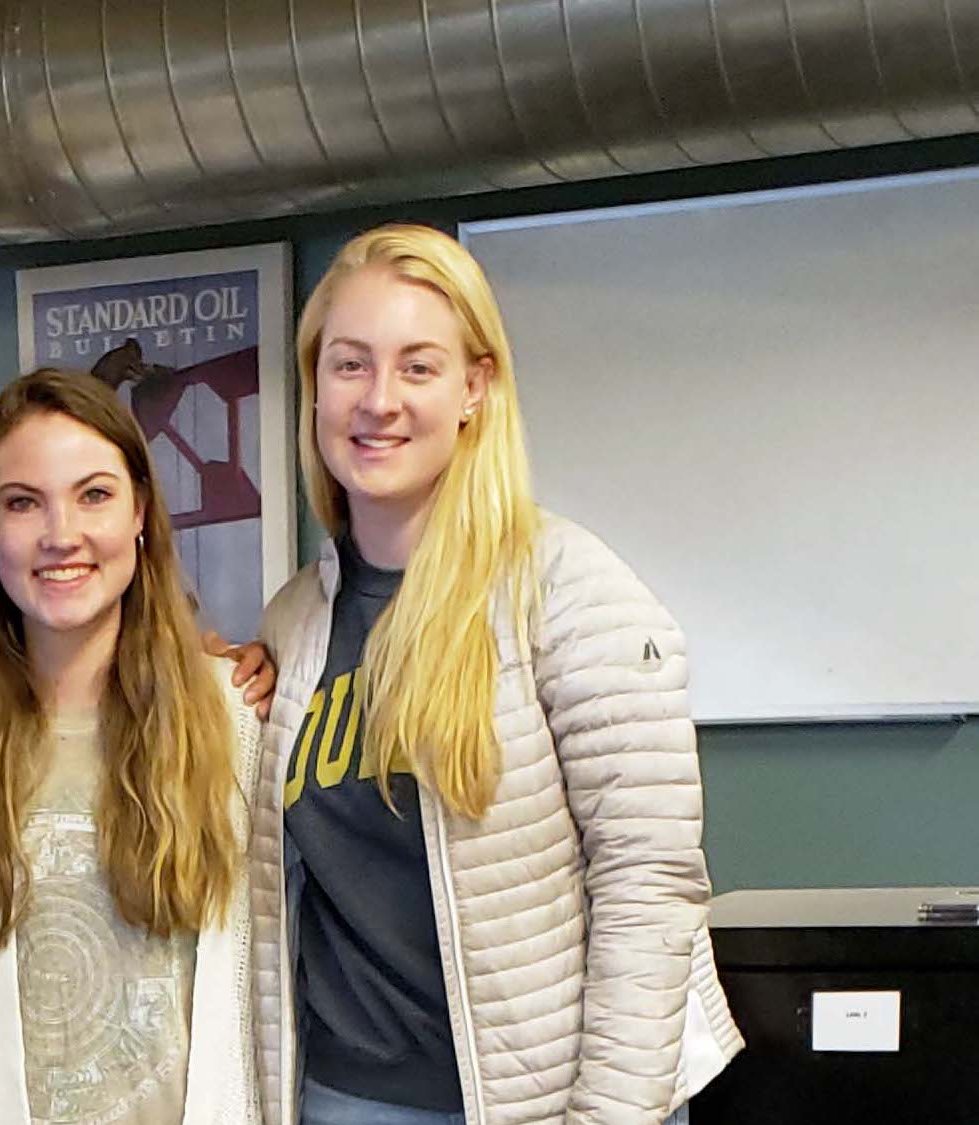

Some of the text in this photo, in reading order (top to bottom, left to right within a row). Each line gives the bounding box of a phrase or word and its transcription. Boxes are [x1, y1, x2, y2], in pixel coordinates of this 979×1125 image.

[46, 286, 248, 337] STANDARD OIL
[48, 322, 246, 360] BULETIN
